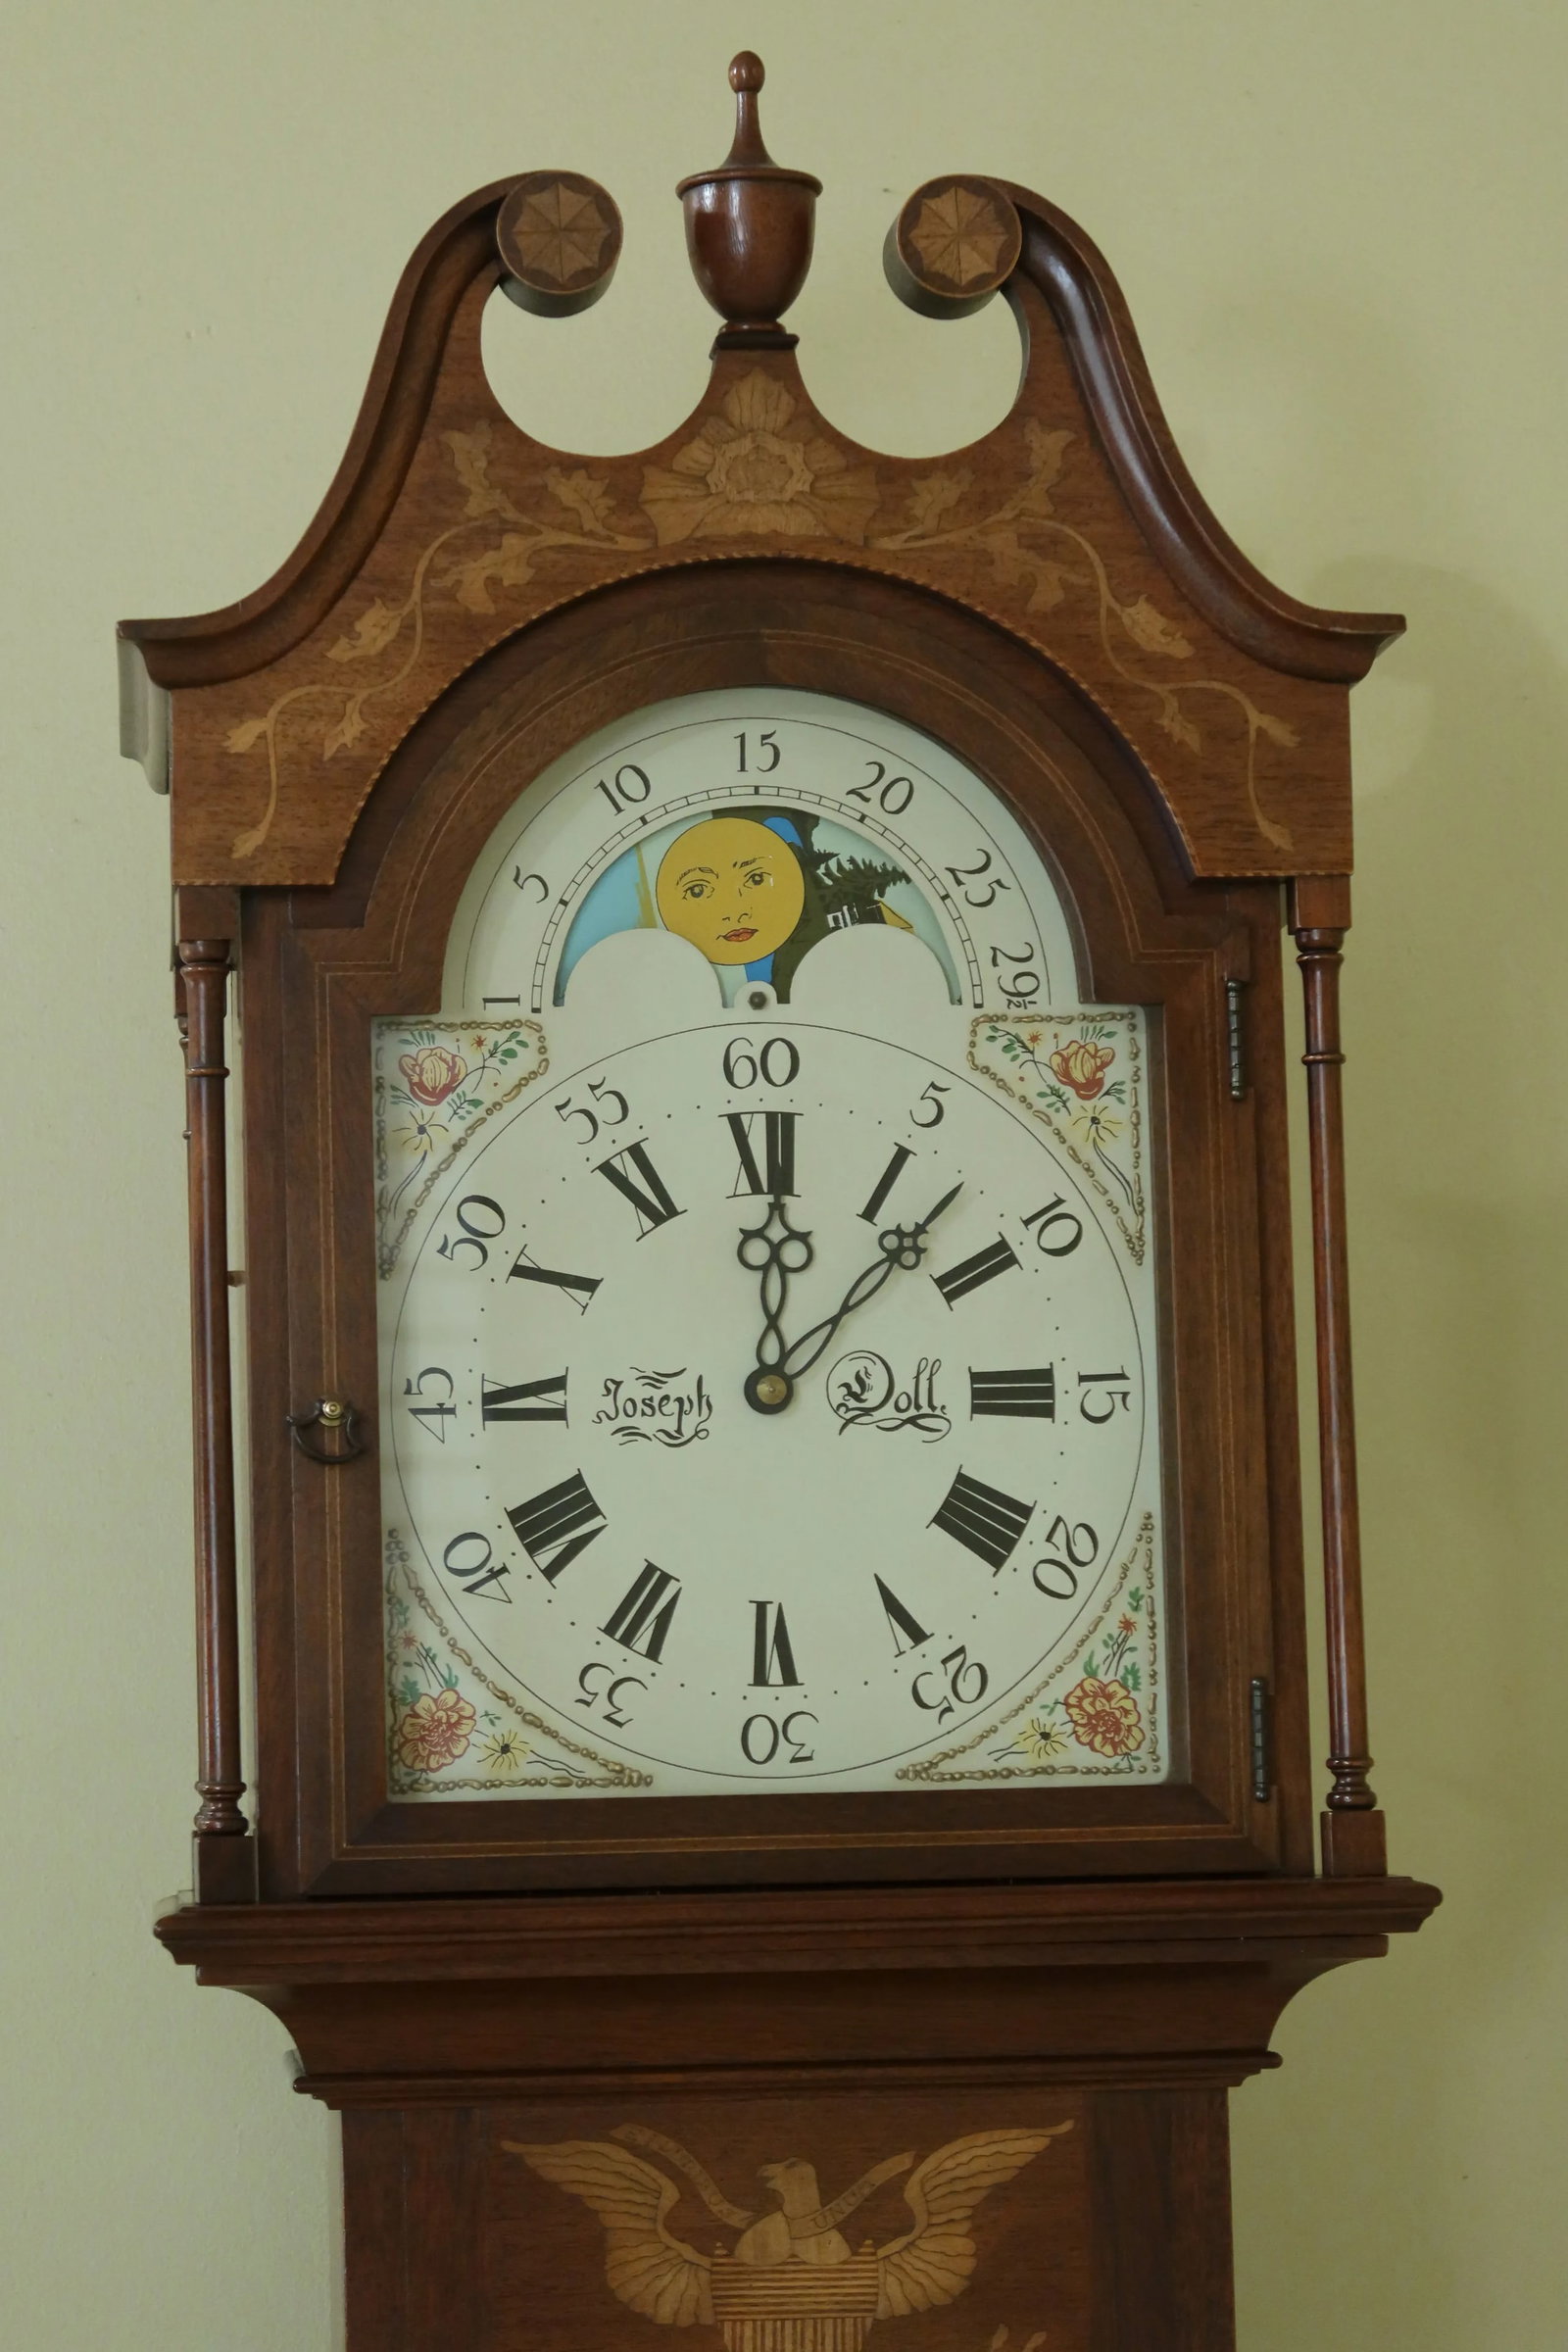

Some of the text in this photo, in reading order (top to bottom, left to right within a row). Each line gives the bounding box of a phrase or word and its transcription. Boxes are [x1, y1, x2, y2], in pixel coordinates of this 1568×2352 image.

[734, 730, 780, 773] 15
[595, 764, 651, 815] 10
[846, 761, 913, 814] 20
[514, 865, 548, 903] 5
[945, 849, 1012, 908] 25
[482, 994, 519, 1011] 1
[723, 1038, 801, 1089] 60
[555, 1077, 629, 1145] 55
[909, 1082, 952, 1128] 5
[718, 1110, 804, 1199] XII
[591, 1137, 688, 1242] XI
[437, 1195, 506, 1271] 50
[1020, 1193, 1083, 1257] 10
[506, 1244, 604, 1315] X
[929, 1232, 1023, 1311] II
[403, 1367, 457, 1444] 45
[482, 1367, 568, 1430] IX
[592, 1373, 713, 1441] Joseph
[968, 1362, 1055, 1423] III
[1077, 1365, 1131, 1425] 15
[444, 1532, 513, 1604] 40
[1033, 1514, 1100, 1599] 20
[596, 1559, 682, 1664] VII
[748, 1600, 805, 1687] VI
[874, 1573, 934, 1657] V
[575, 1662, 648, 1728] 35
[911, 1645, 989, 1724] 25
[740, 1711, 819, 1765] 30
